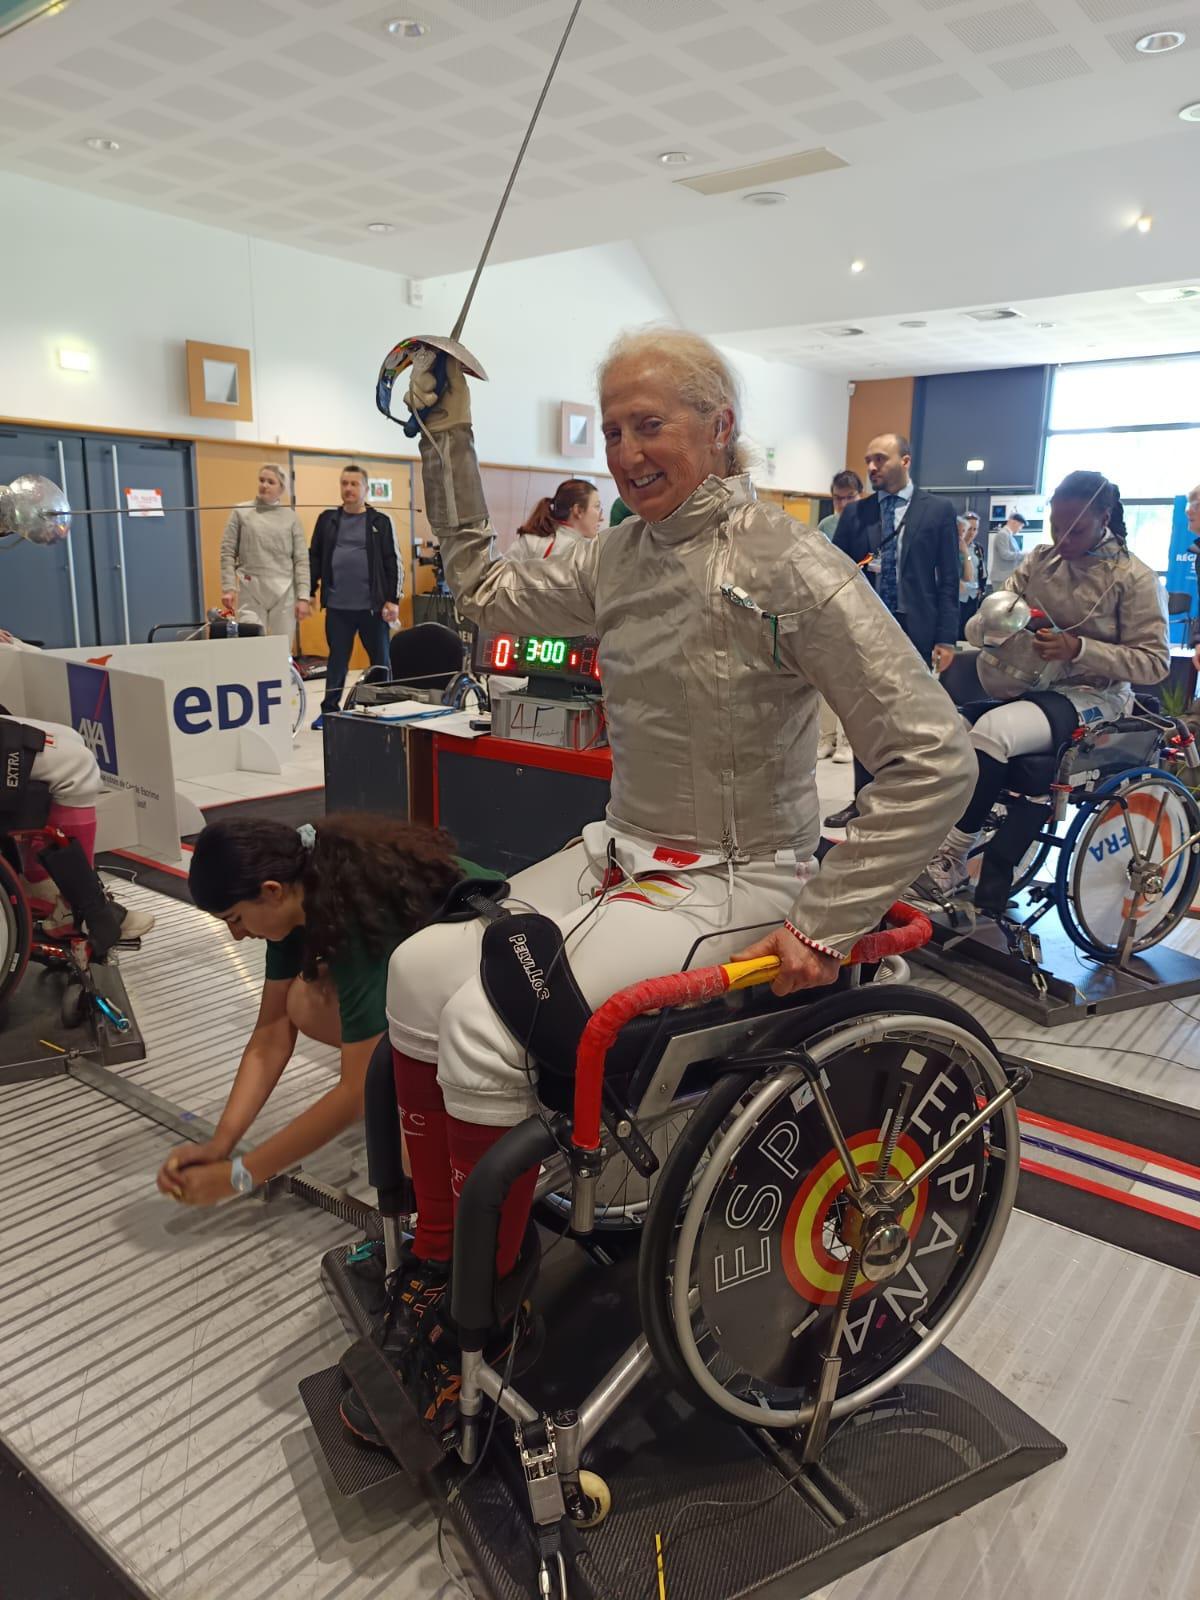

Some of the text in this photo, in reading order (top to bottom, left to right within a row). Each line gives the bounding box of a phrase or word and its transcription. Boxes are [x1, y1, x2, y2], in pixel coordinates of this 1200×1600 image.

[494, 638, 511, 668] 0
[525, 638, 566, 664] 3:00
[173, 680, 282, 735] eDF
[79, 717, 111, 765] AXA
[1088, 826, 1131, 863] FRA
[713, 1119, 801, 1293] ESP
